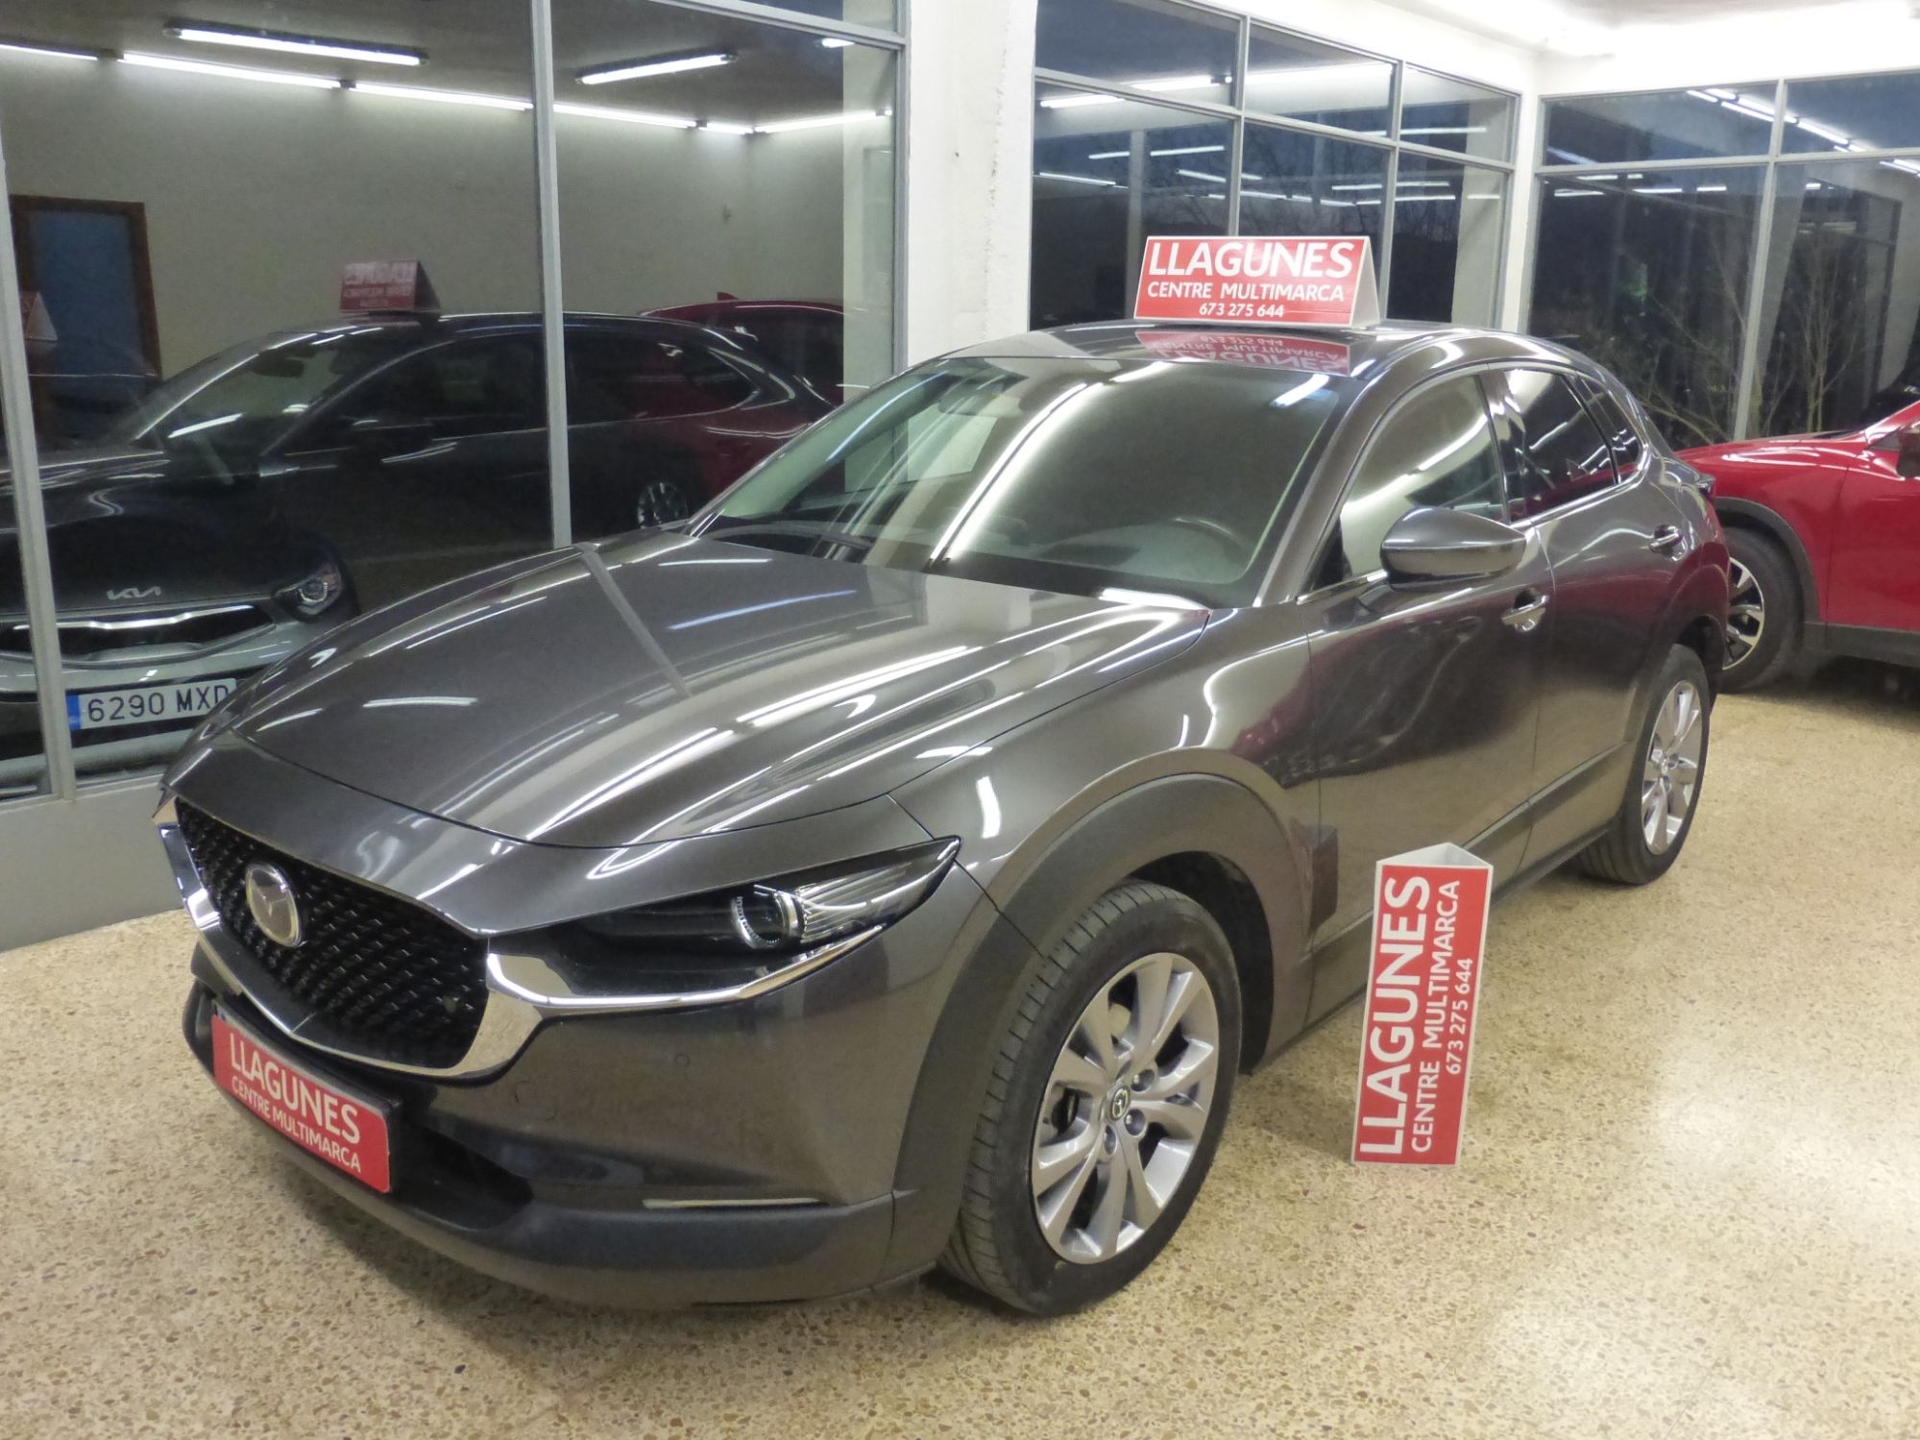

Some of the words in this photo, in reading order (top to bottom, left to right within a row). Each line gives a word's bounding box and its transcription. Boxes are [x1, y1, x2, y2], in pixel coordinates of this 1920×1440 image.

[1148, 242, 1355, 279] LLAGUNES
[1147, 281, 1212, 299] CENTRE
[1220, 283, 1344, 302] MULTIMARCA
[1199, 302, 1225, 316] 673
[1228, 303, 1253, 317] 275
[1257, 304, 1284, 318] 644
[88, 692, 165, 722] 6290
[1422, 880, 1460, 1048] MULTIMARCA
[1455, 958, 1473, 994] 644
[1359, 876, 1430, 1154] LLAGUNES
[1450, 999, 1468, 1036] 275
[1446, 1039, 1463, 1074] 673
[230, 1033, 360, 1144] LLAGUNES
[1411, 1060, 1440, 1152] CENTRE
[232, 1076, 270, 1120] CENTRE
[272, 1106, 362, 1173] MULTIMARCA
